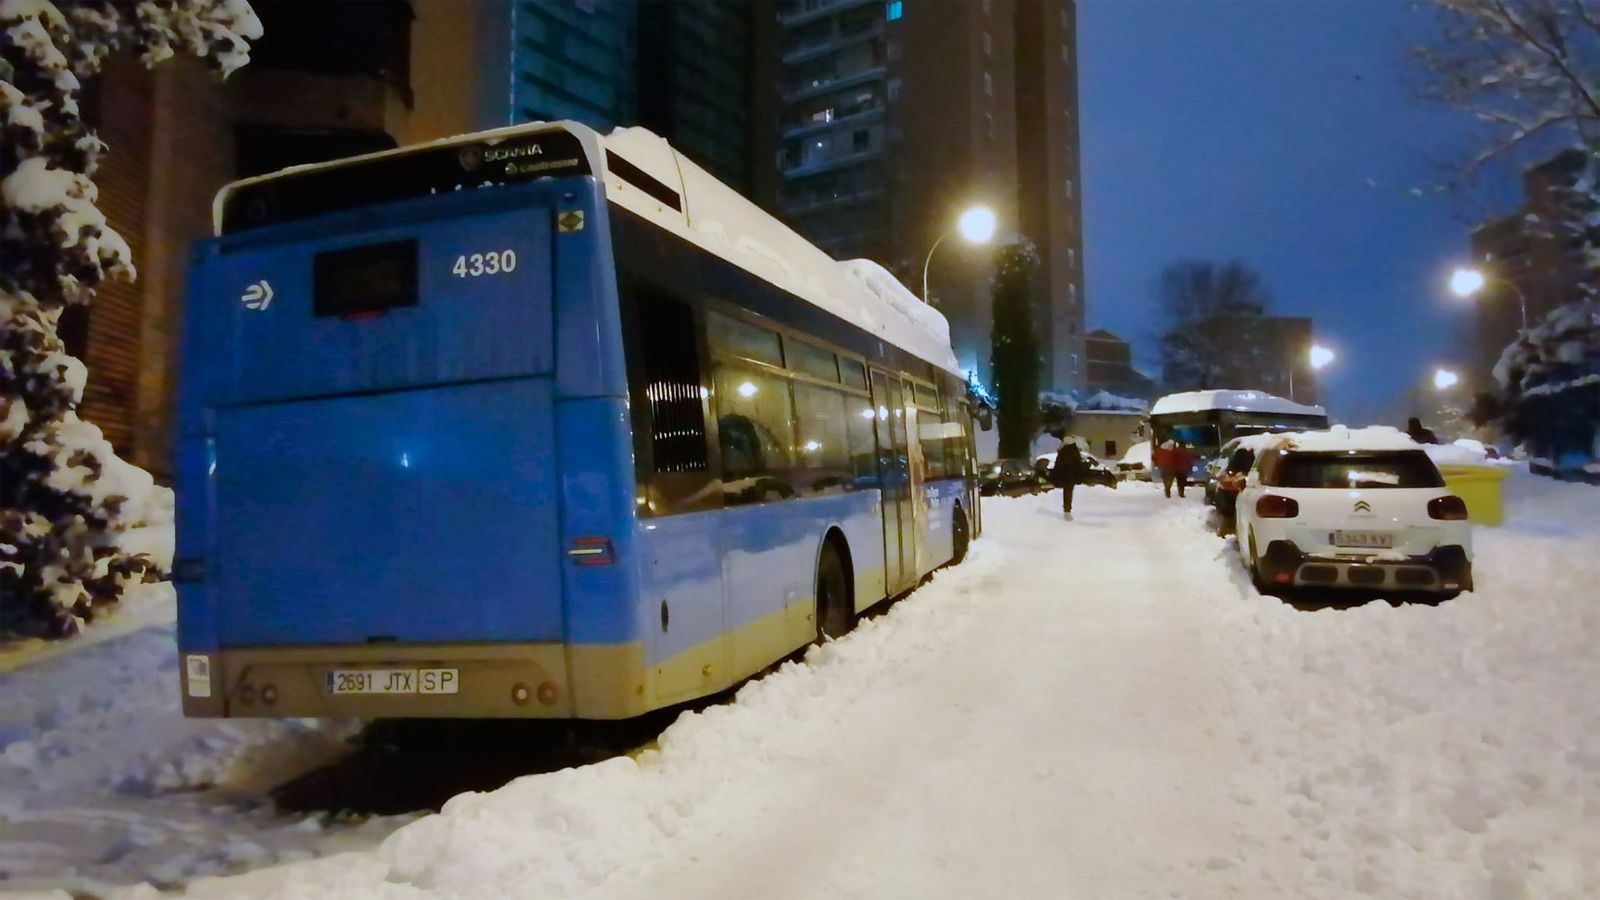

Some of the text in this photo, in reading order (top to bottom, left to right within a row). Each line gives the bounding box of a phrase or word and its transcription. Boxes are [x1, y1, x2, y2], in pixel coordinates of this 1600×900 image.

[484, 143, 543, 162] SCANIA
[452, 249, 517, 278] 4330
[338, 671, 454, 691] 2691 JTX SP
